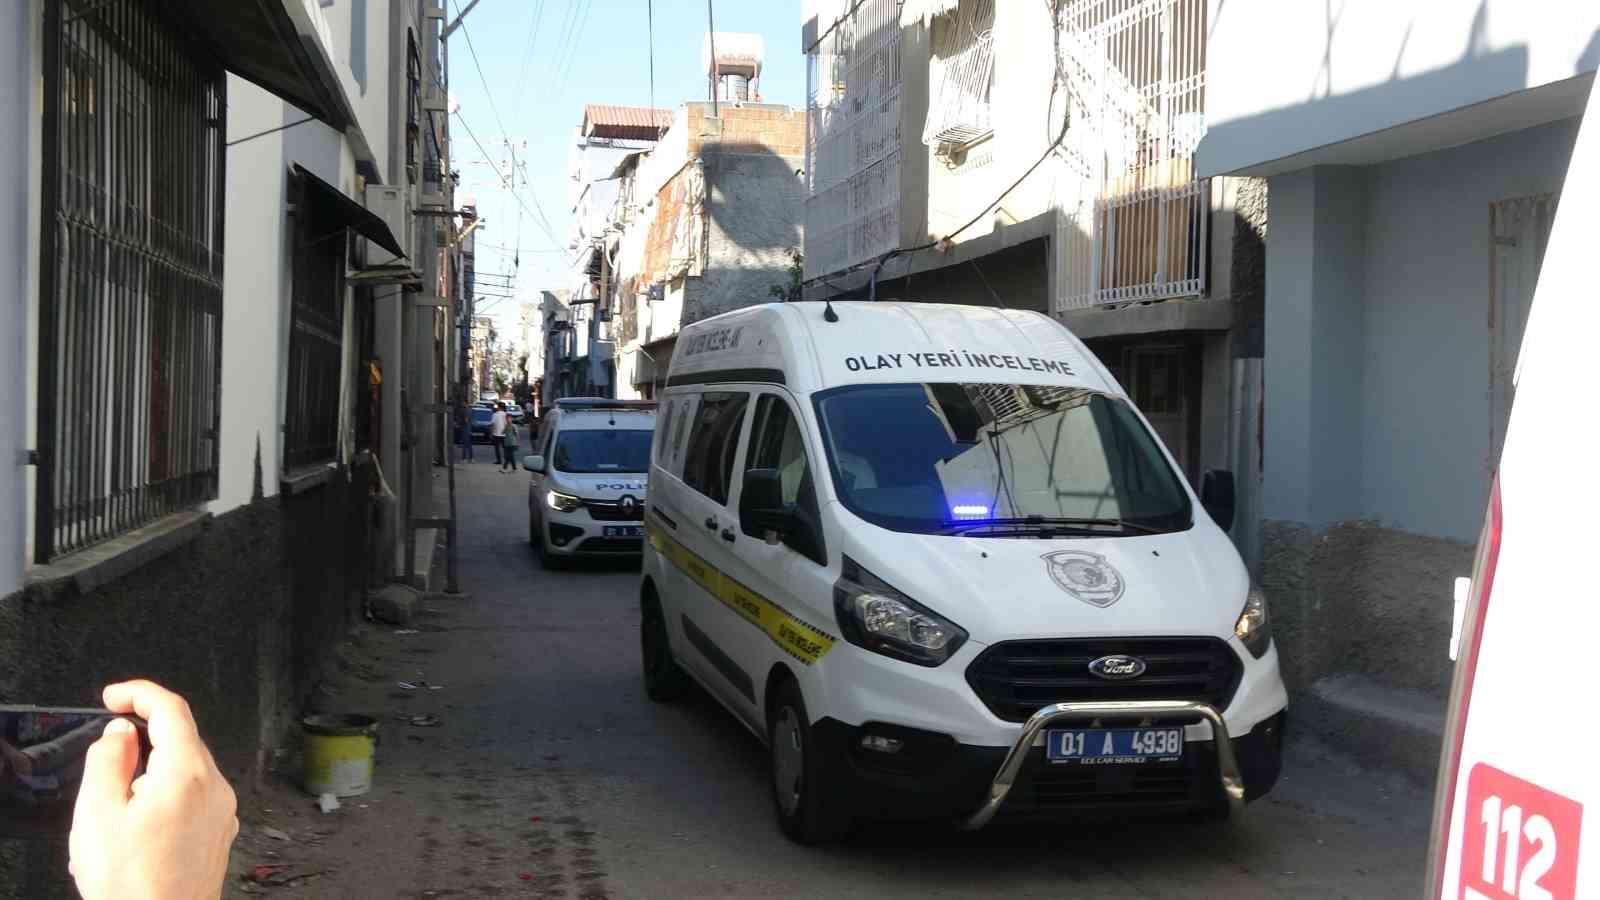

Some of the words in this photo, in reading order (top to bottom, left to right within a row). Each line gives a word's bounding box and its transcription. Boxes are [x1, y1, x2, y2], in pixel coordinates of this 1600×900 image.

[845, 353, 902, 372] OLAY
[908, 349, 961, 368] YERİ
[963, 350, 1076, 376] İNCELEME
[1103, 658, 1137, 674] Ford
[1061, 732, 1085, 756] 01
[1102, 731, 1114, 755] A
[1131, 730, 1179, 754] 4938
[1481, 795, 1556, 900] 112
